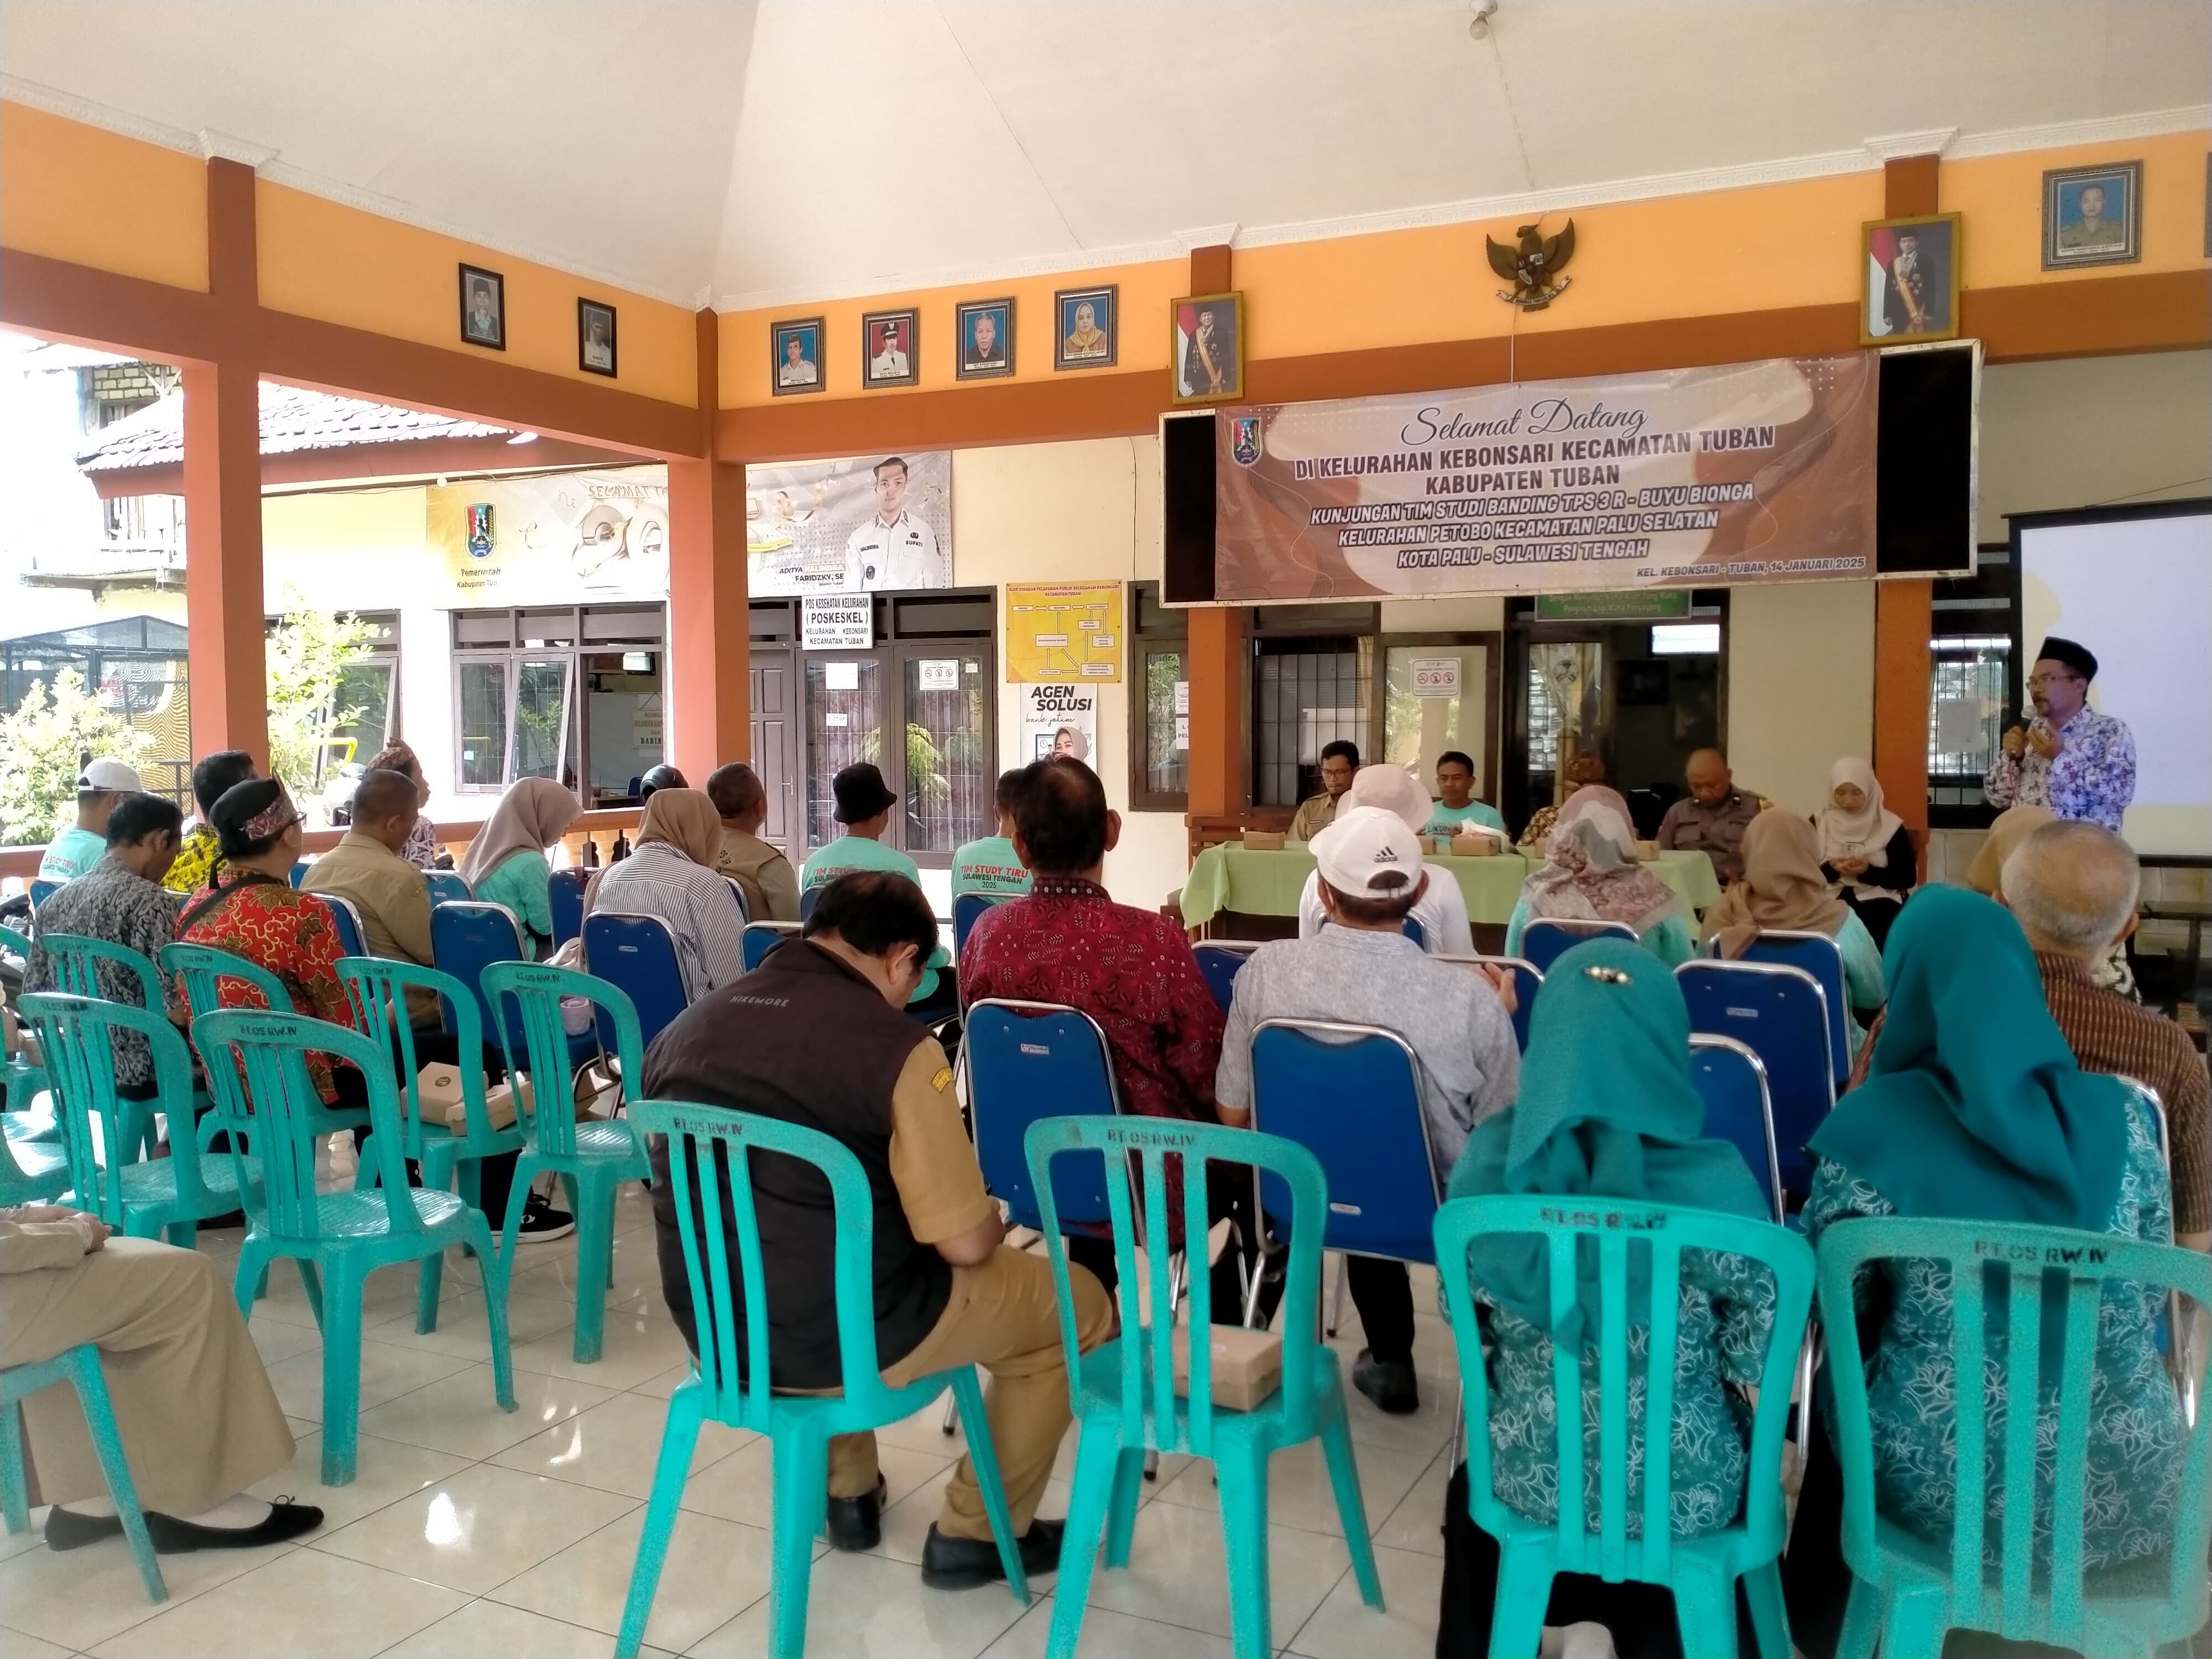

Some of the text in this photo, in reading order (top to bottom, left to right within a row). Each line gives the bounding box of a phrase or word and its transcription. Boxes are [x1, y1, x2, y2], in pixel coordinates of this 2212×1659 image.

[1401, 397, 1649, 446] Selamat Datang
[1296, 425, 1775, 479] DI KELURAHAN KEBONSARI KECAMATAN TUBAN
[1426, 465, 1620, 495] KABUPATEN TUBAN
[588, 486, 649, 498] SELAMAT
[1310, 503, 1402, 525] KUNJUNGAN
[1403, 502, 1433, 520] TIM
[1434, 499, 1484, 519] STUDI
[1486, 492, 1558, 515] BANDING
[1562, 492, 1597, 513] TPS
[1597, 492, 1612, 510] 3
[1611, 490, 1626, 509] R
[1637, 486, 1689, 508] BUYU
[1689, 483, 1754, 504] BIONGA
[1338, 510, 1719, 547] KELURAHAN PETOBO KECAMATAN PALU SELATAN
[1397, 549, 1438, 568] KOTA
[1440, 547, 1482, 567] PALU
[1493, 542, 1579, 565] SULAWESI
[1580, 539, 1650, 560] TENGAH
[461, 567, 501, 577] Pemerintah
[1637, 567, 1658, 577] KEL.
[1661, 564, 1720, 576] KEBONSARI
[1728, 562, 1768, 575] TUBAN,
[1770, 561, 1783, 572] 14
[1785, 559, 1834, 571] JANUARI
[1835, 557, 1865, 568] 2025
[805, 597, 869, 609] POS KESEHATAN KELURAHAN
[811, 612, 863, 624] POSKESKEL
[1030, 685, 1075, 698] AGEN
[1036, 698, 1092, 711] SOLUSI
[1025, 712, 1075, 727] bank jatim
[961, 864, 1029, 879] TIM STUDY TIRU
[962, 873, 1022, 885] SULAWESI TENGAH
[982, 880, 997, 889] 2025
[729, 995, 790, 1008] HIKEMORE
